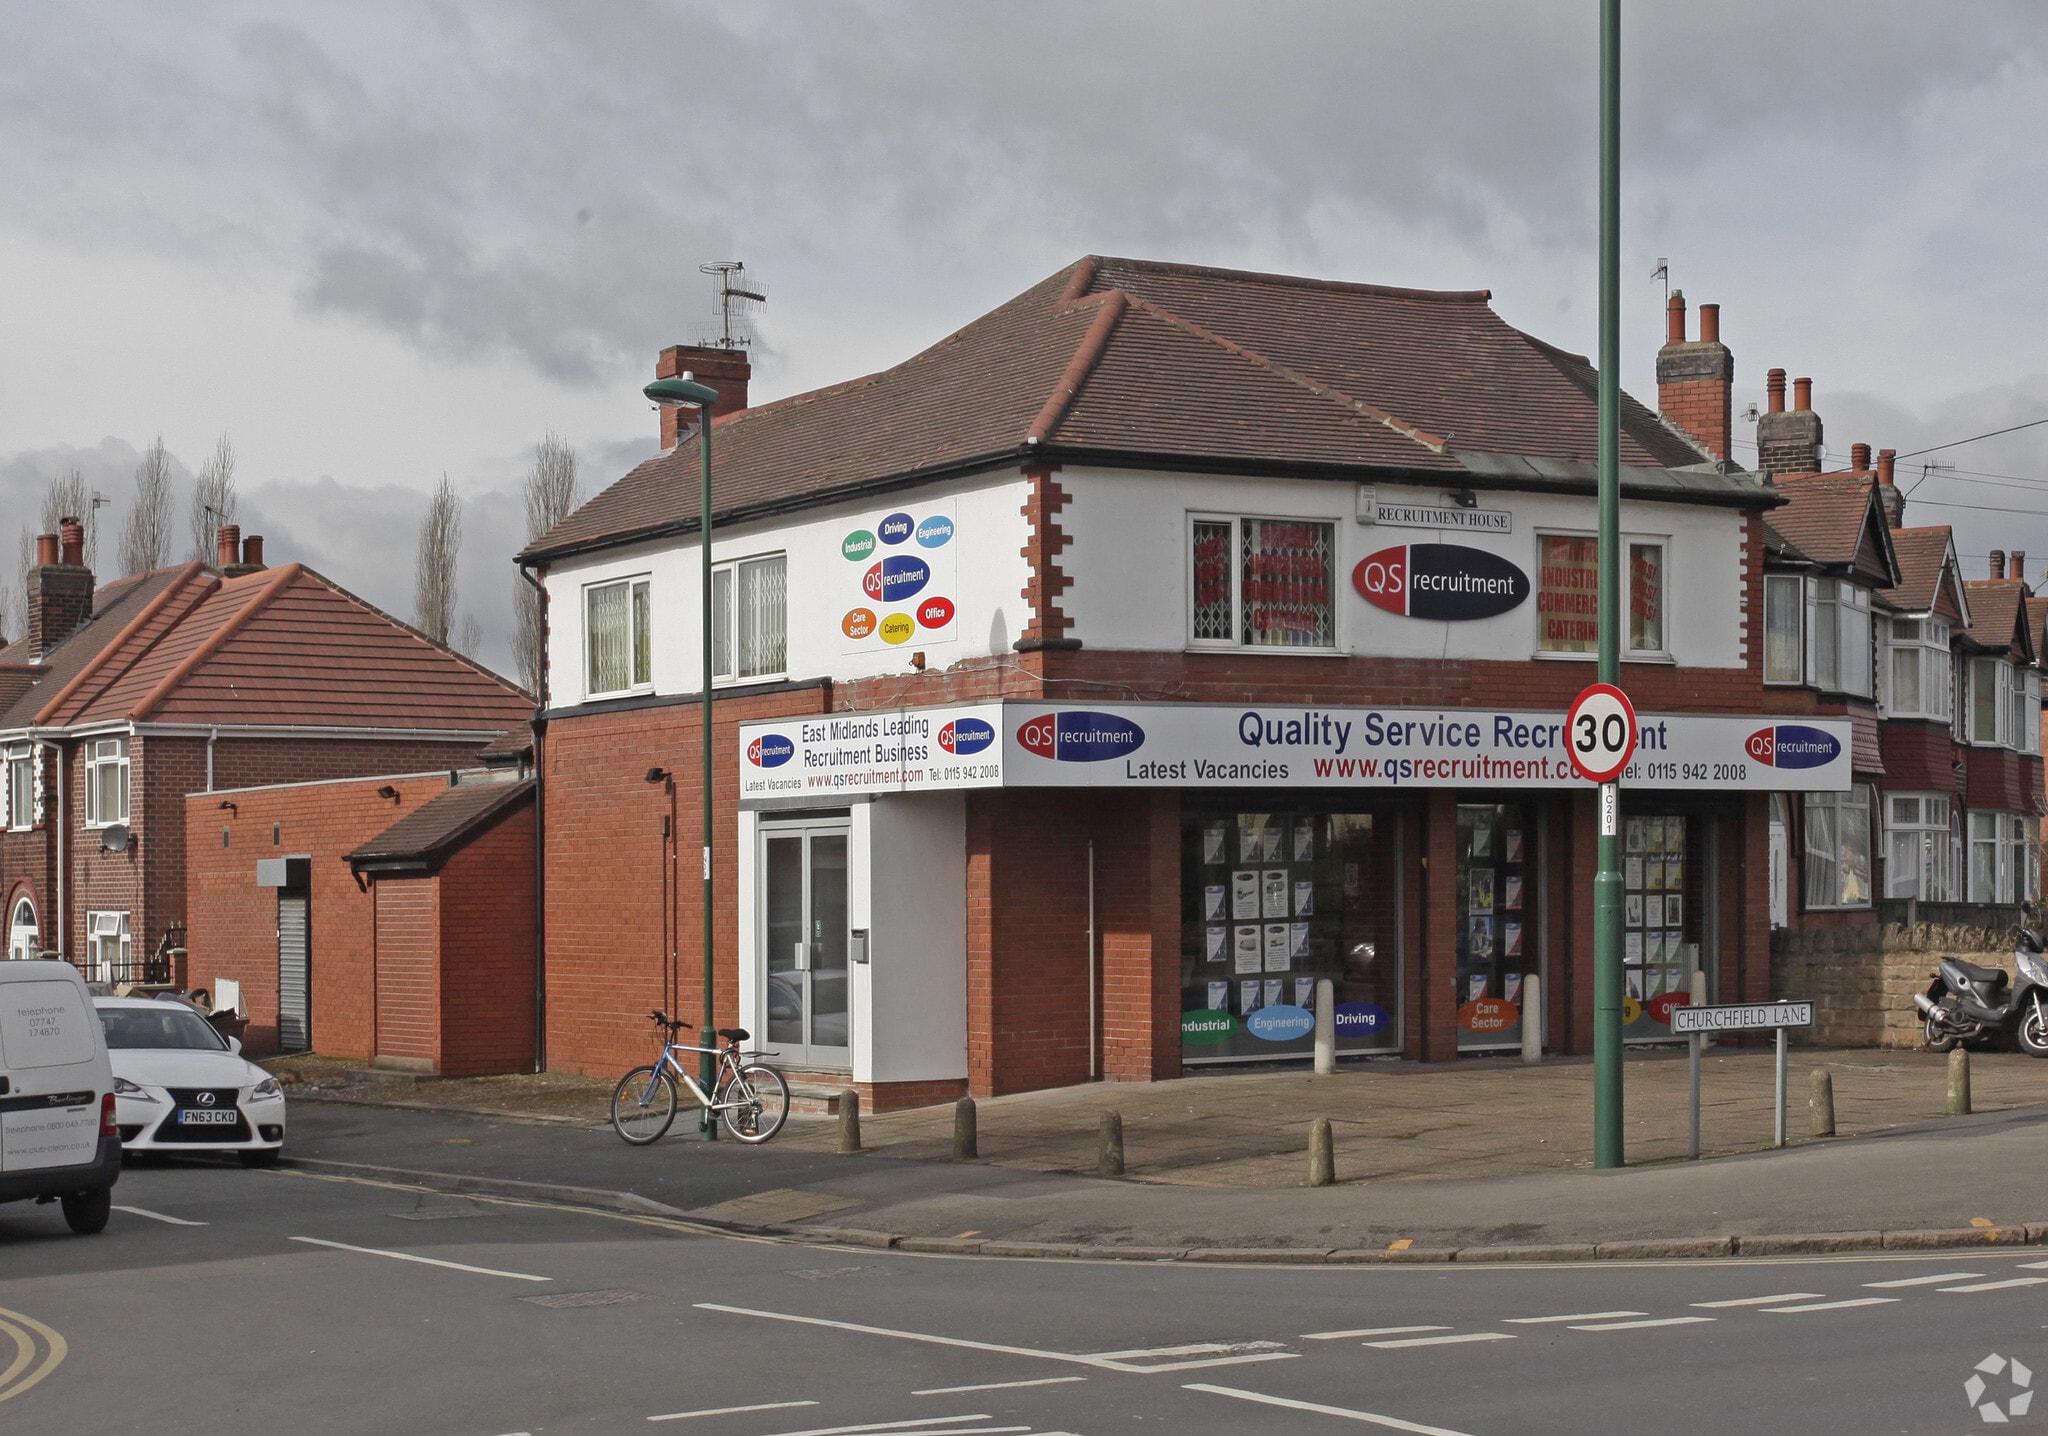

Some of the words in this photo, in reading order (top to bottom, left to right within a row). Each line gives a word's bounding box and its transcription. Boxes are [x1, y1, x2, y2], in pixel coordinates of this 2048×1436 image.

[1378, 507, 1466, 525] RECRUITMENT
[1469, 513, 1508, 528] HOUSE
[885, 522, 907, 535] Driving
[919, 524, 951, 539] Engineering
[845, 536, 873, 553] Industrial
[866, 572, 881, 592] QS
[884, 568, 924, 586] recruitment
[1364, 562, 1402, 594] QS
[1413, 571, 1514, 595] recruitment
[1542, 566, 1598, 589] INDUSTRI
[1537, 591, 1598, 615] COMMERC
[852, 612, 866, 623] Care
[925, 607, 945, 619] Office
[850, 625, 869, 636] Sector
[884, 623, 909, 634] Catering
[1548, 619, 1598, 641] CATERIN
[802, 724, 826, 743] East
[830, 718, 878, 740] Midlands
[883, 714, 929, 739] Leading
[940, 729, 954, 745] QS
[956, 729, 990, 742] recruitment
[1025, 725, 1053, 746] QS
[1060, 728, 1133, 743] recruitment
[1239, 711, 1352, 754] Quality
[1365, 712, 1481, 747] Service
[1494, 715, 1667, 750] Recrnt
[1575, 713, 1626, 753] 30
[749, 745, 760, 759] QS
[762, 745, 791, 756] recruitment
[804, 746, 871, 768] Recruitment
[875, 742, 928, 763] Business
[1751, 737, 1772, 756] QS
[1777, 740, 1832, 754] recruitment
[929, 768, 941, 781] Tel:
[944, 768, 961, 781] 0115
[963, 767, 977, 780] 942
[980, 765, 999, 779] 2008
[1126, 759, 1186, 779] Latest
[1194, 759, 1289, 779] Vacancies
[1313, 754, 1582, 784] www.qsrecruitment.co
[1648, 762, 1677, 780] 0115
[1682, 763, 1708, 780] 942
[1713, 764, 1747, 781] 2008
[745, 780, 766, 791] Latest
[768, 777, 802, 790] Vacancies
[808, 768, 924, 790] www.qsrecruitment.com
[17, 1006, 65, 1017] telephone
[1476, 1002, 1499, 1014] Care
[1181, 1019, 1230, 1032] ndustrial
[1254, 1015, 1309, 1030] Engineering
[1336, 1012, 1376, 1026] Driving
[1471, 1016, 1504, 1028] Sector
[1677, 1009, 1766, 1029] CHURCHFIELD
[1774, 1006, 1807, 1024] LANE
[184, 1111, 212, 1123] FN63
